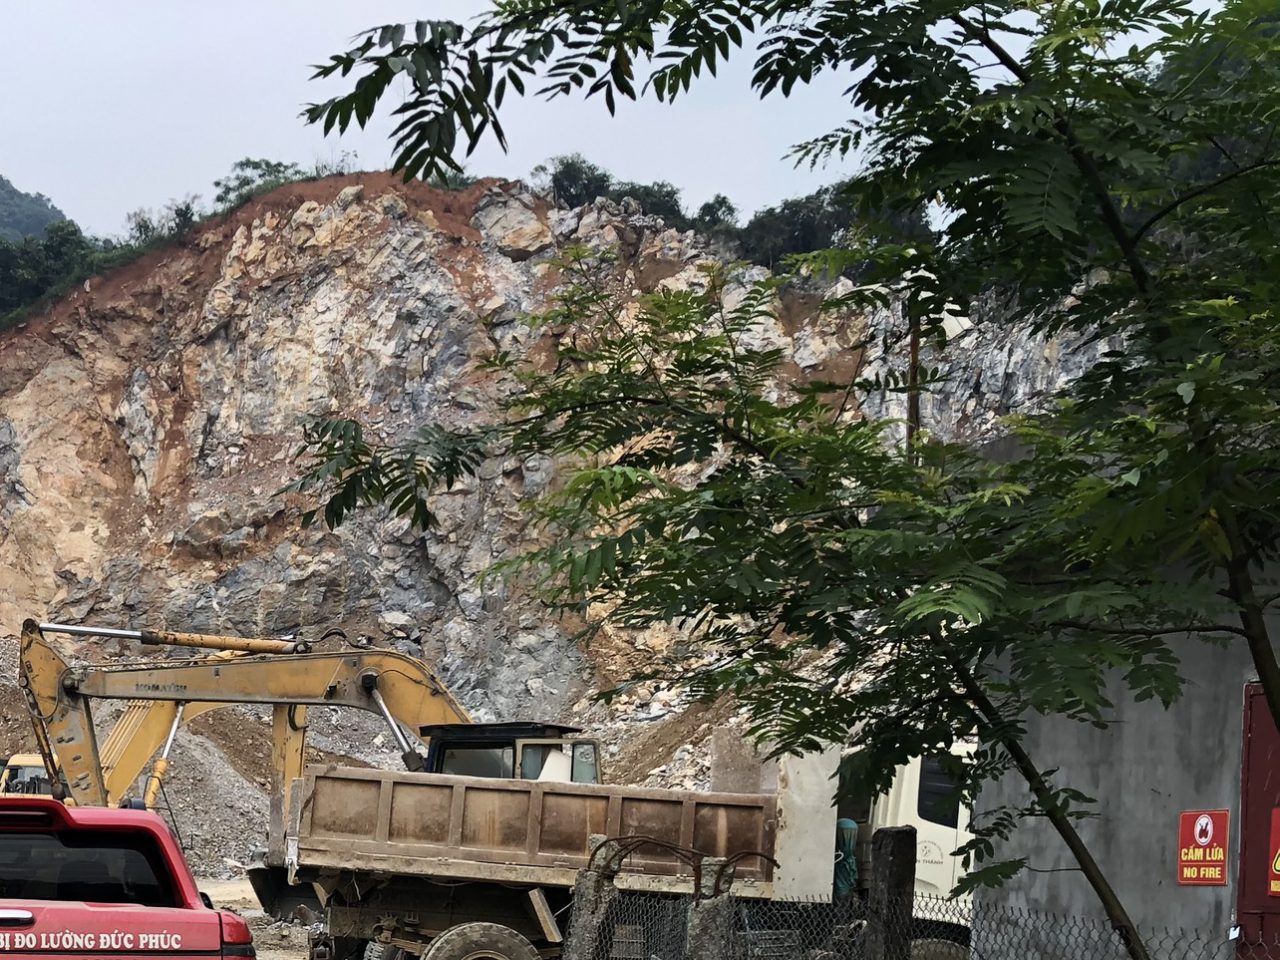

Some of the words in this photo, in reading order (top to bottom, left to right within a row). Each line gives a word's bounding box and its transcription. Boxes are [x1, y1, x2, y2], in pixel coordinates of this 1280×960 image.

[1181, 843, 1203, 861] CẤM
[1206, 842, 1225, 861] LỬA
[1183, 867, 1197, 878] NO
[1200, 867, 1222, 879] FIRE
[14, 933, 37, 949] ĐO
[40, 929, 95, 949] LƯỜNG
[99, 930, 134, 950] ĐỨC
[138, 929, 182, 950] PHÚC
